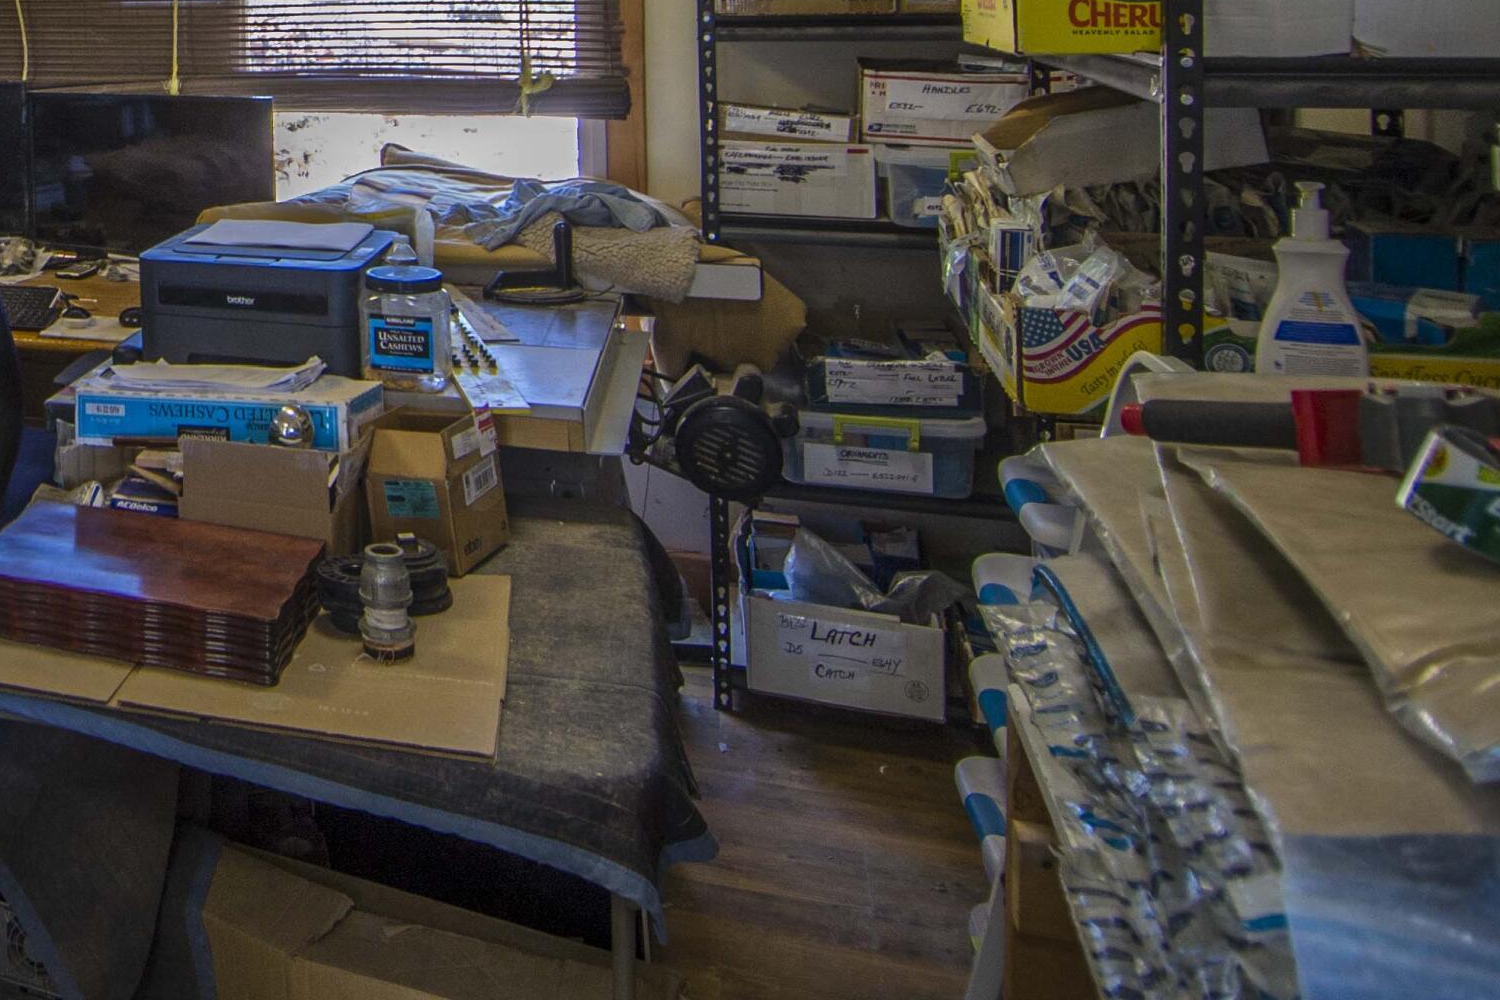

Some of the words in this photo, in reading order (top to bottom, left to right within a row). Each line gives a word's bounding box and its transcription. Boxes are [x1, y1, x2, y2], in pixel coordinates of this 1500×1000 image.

[226, 295, 255, 306] brother
[378, 330, 425, 344] UNSALTED
[379, 340, 424, 353] CASHEWS
[1065, 332, 1107, 362] USA
[1033, 352, 1065, 374] GROWN
[1080, 373, 1109, 396] Tasty
[149, 404, 230, 423] CASHEWS
[116, 500, 158, 512] ACDelco
[810, 620, 876, 647] LATCH
[814, 663, 855, 680] CATCH
